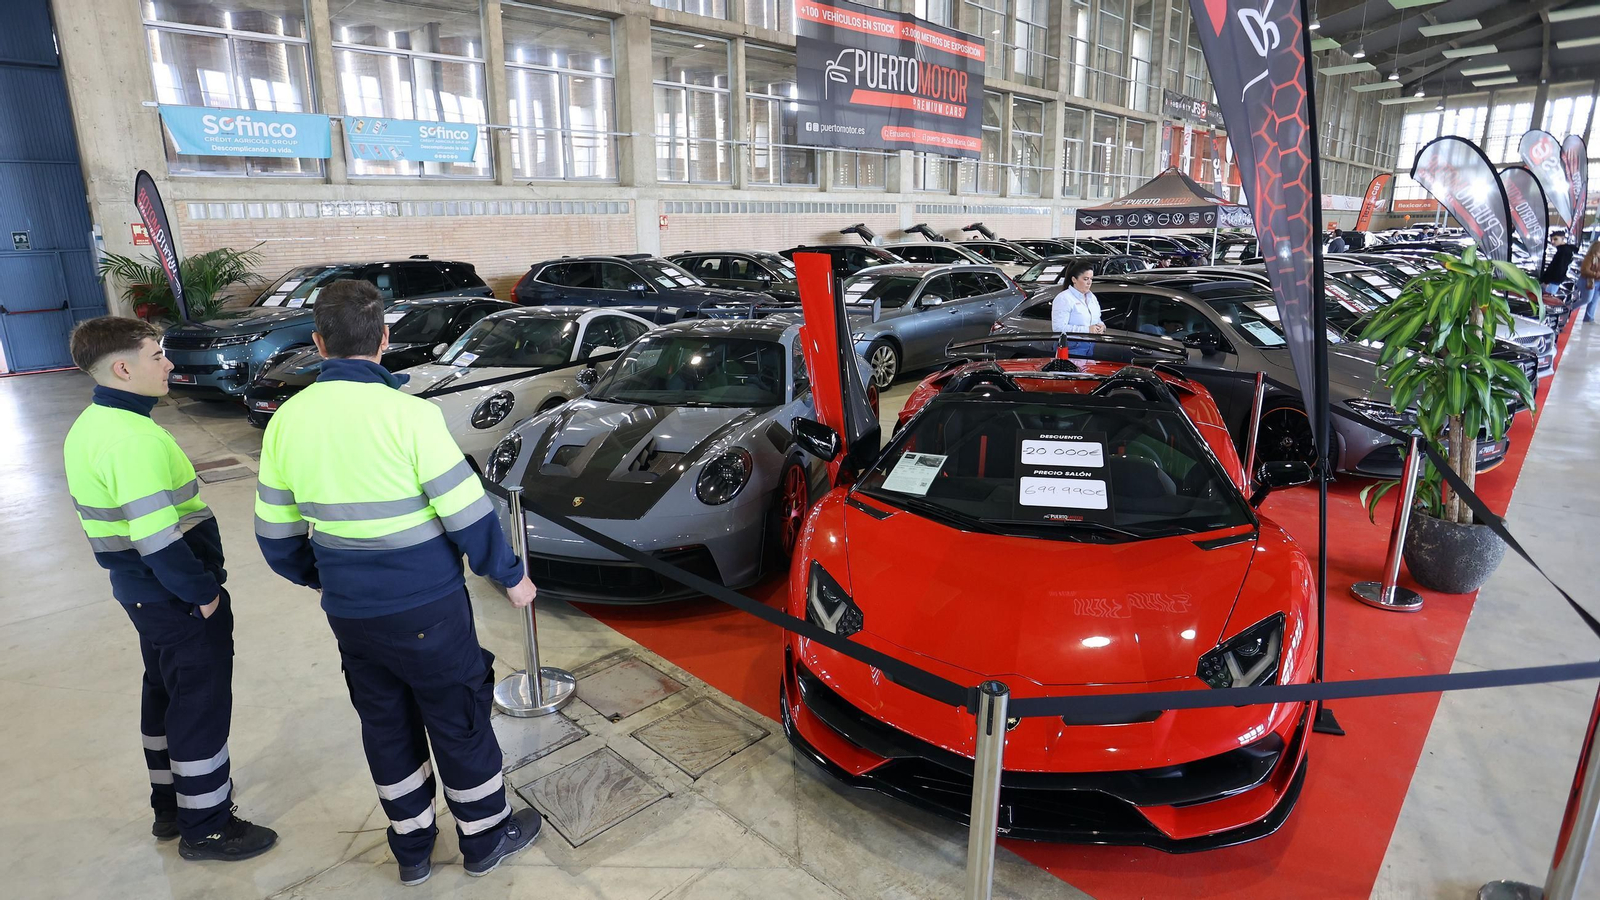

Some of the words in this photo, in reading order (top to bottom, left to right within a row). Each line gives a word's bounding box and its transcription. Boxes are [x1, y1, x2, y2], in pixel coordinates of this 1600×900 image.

[801, 6, 819, 18] +100
[822, 9, 862, 28] VEHÍCULOS
[863, 20, 872, 30] EN
[872, 22, 895, 34] STOCK
[901, 26, 920, 40] +3.000
[920, 31, 943, 47] METROS
[943, 39, 951, 48] DE
[951, 40, 981, 57] EXPOSICIÓN
[913, 98, 943, 114] PREMIUM
[945, 105, 963, 117] CARS
[202, 115, 297, 139] Sofinco
[419, 126, 469, 140] Sofinco
[820, 123, 865, 135] puertomotor.es
[211, 145, 269, 153] Descomplicando
